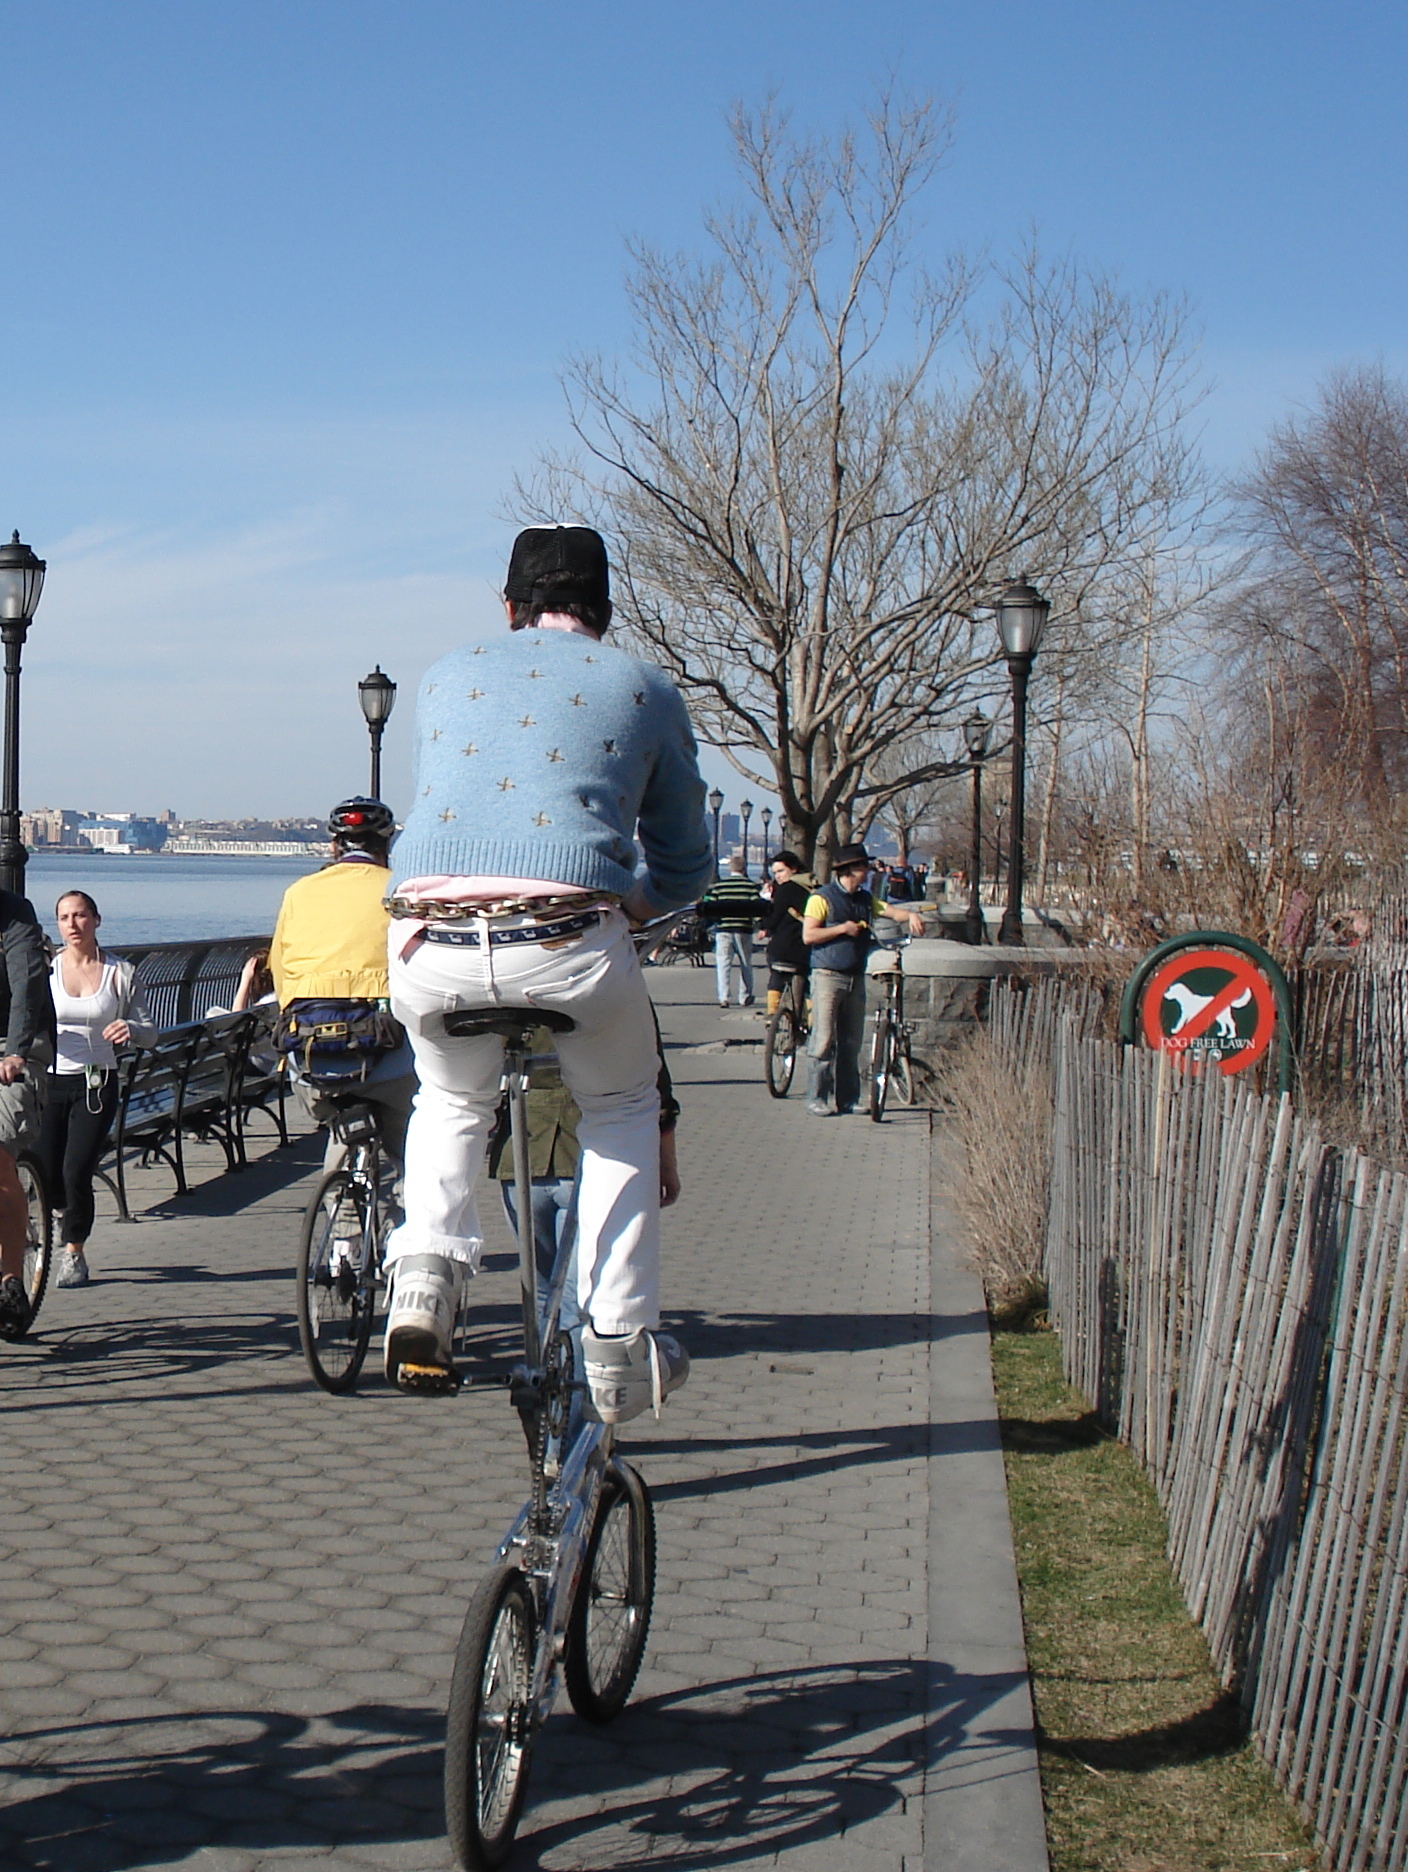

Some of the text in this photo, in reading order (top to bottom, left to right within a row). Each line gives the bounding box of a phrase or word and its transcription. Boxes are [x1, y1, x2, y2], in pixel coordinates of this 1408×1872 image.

[1161, 1037, 1256, 1050] DOG FREE LAWN
